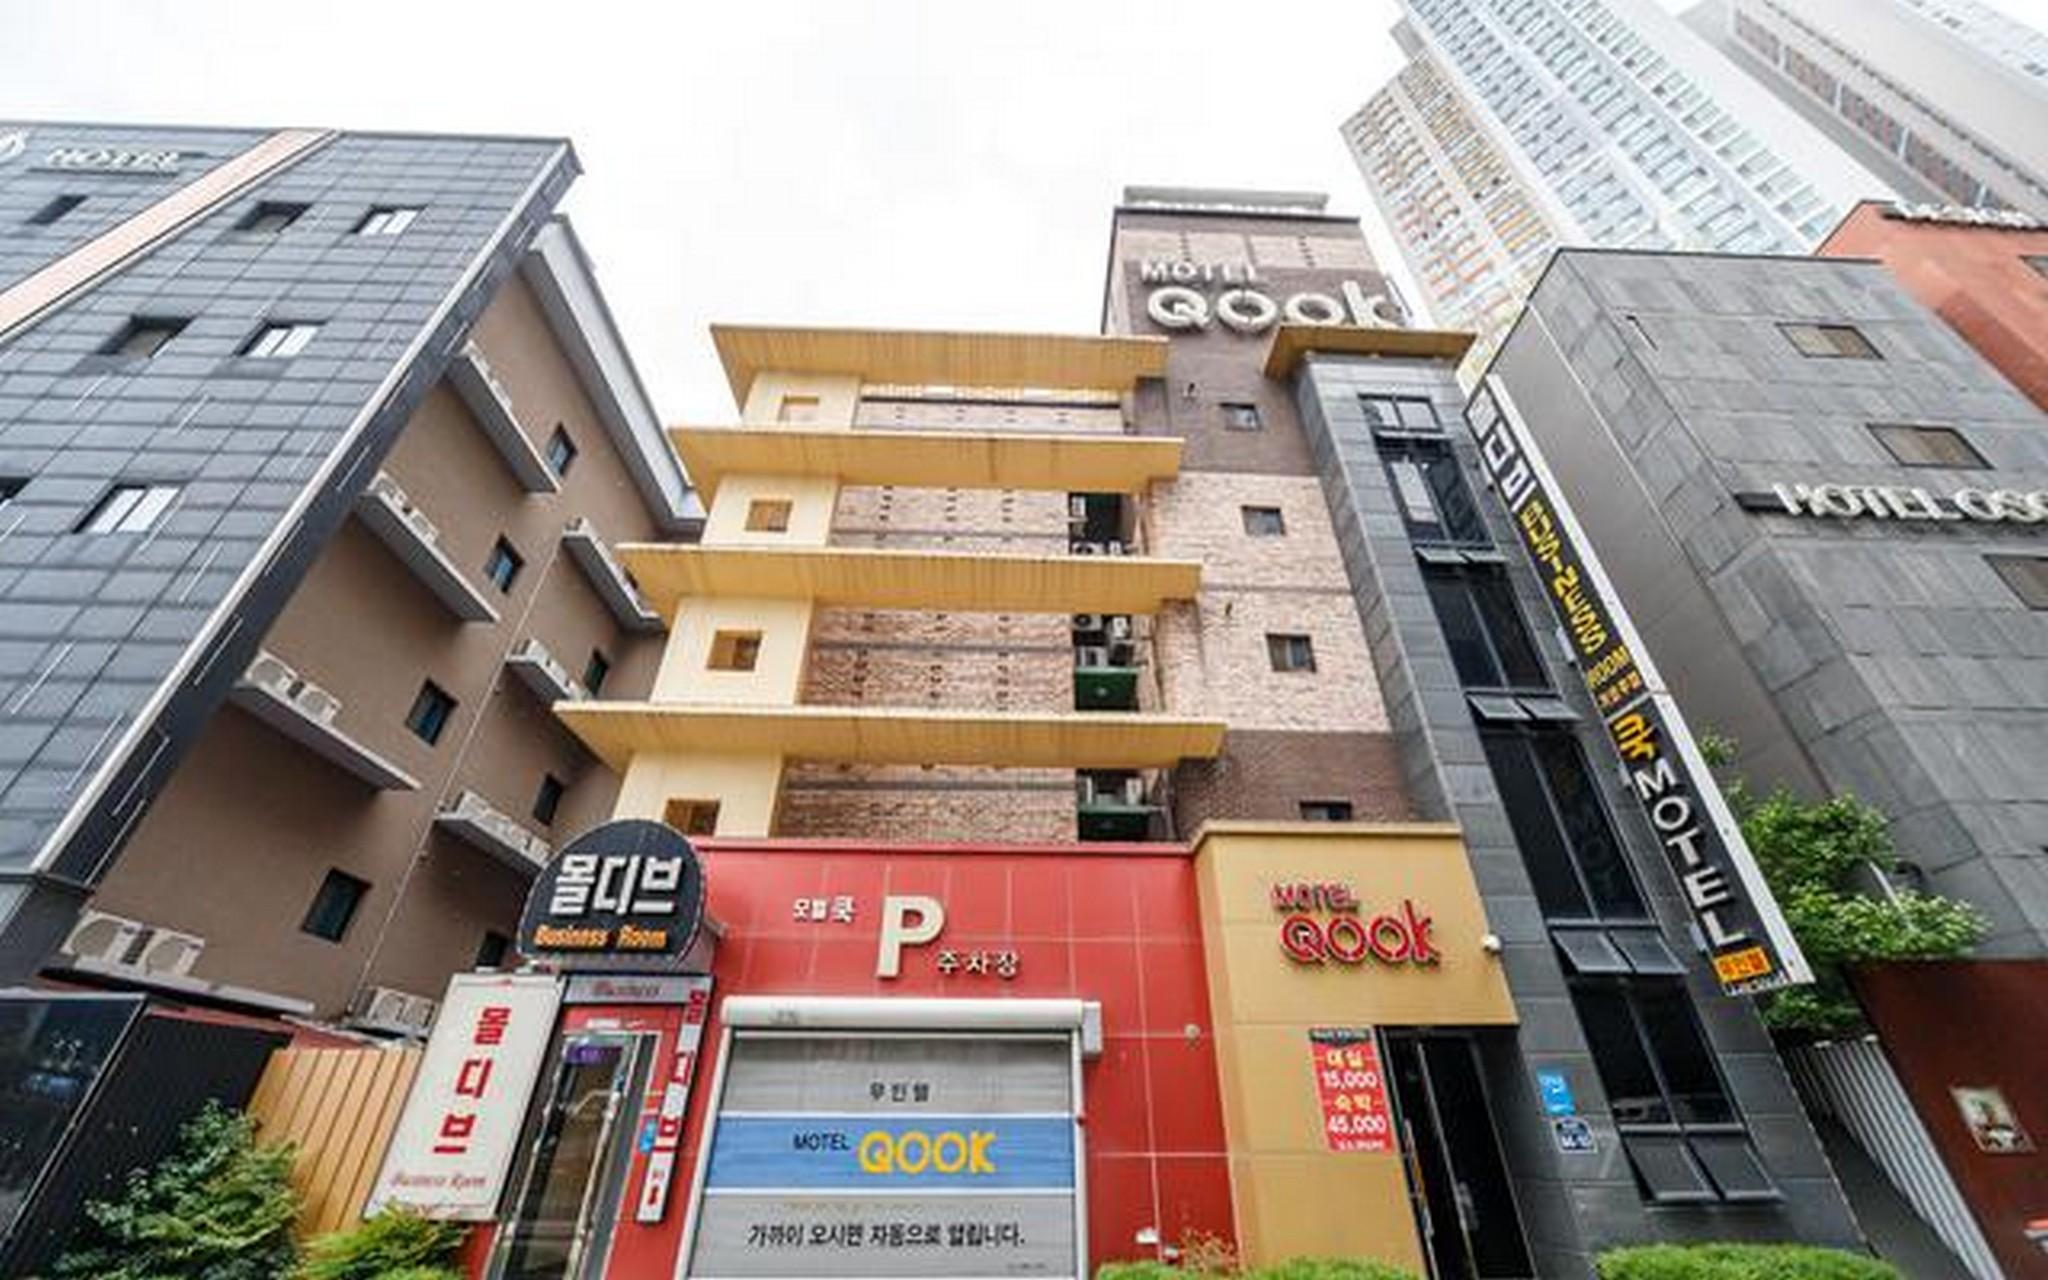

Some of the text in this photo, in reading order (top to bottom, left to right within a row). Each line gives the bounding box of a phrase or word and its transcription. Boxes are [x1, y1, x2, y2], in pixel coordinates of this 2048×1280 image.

[1771, 482, 1963, 519] HOTEL
[1634, 757, 1748, 948] MOTEL
[550, 854, 683, 915] 몰디브
[876, 894, 946, 978] P
[937, 949, 1019, 979] 주차장
[433, 1007, 512, 1154] 몰디브
[794, 1130, 996, 1174] MOTEL QOOK
[809, 1224, 864, 1247] 오시면
